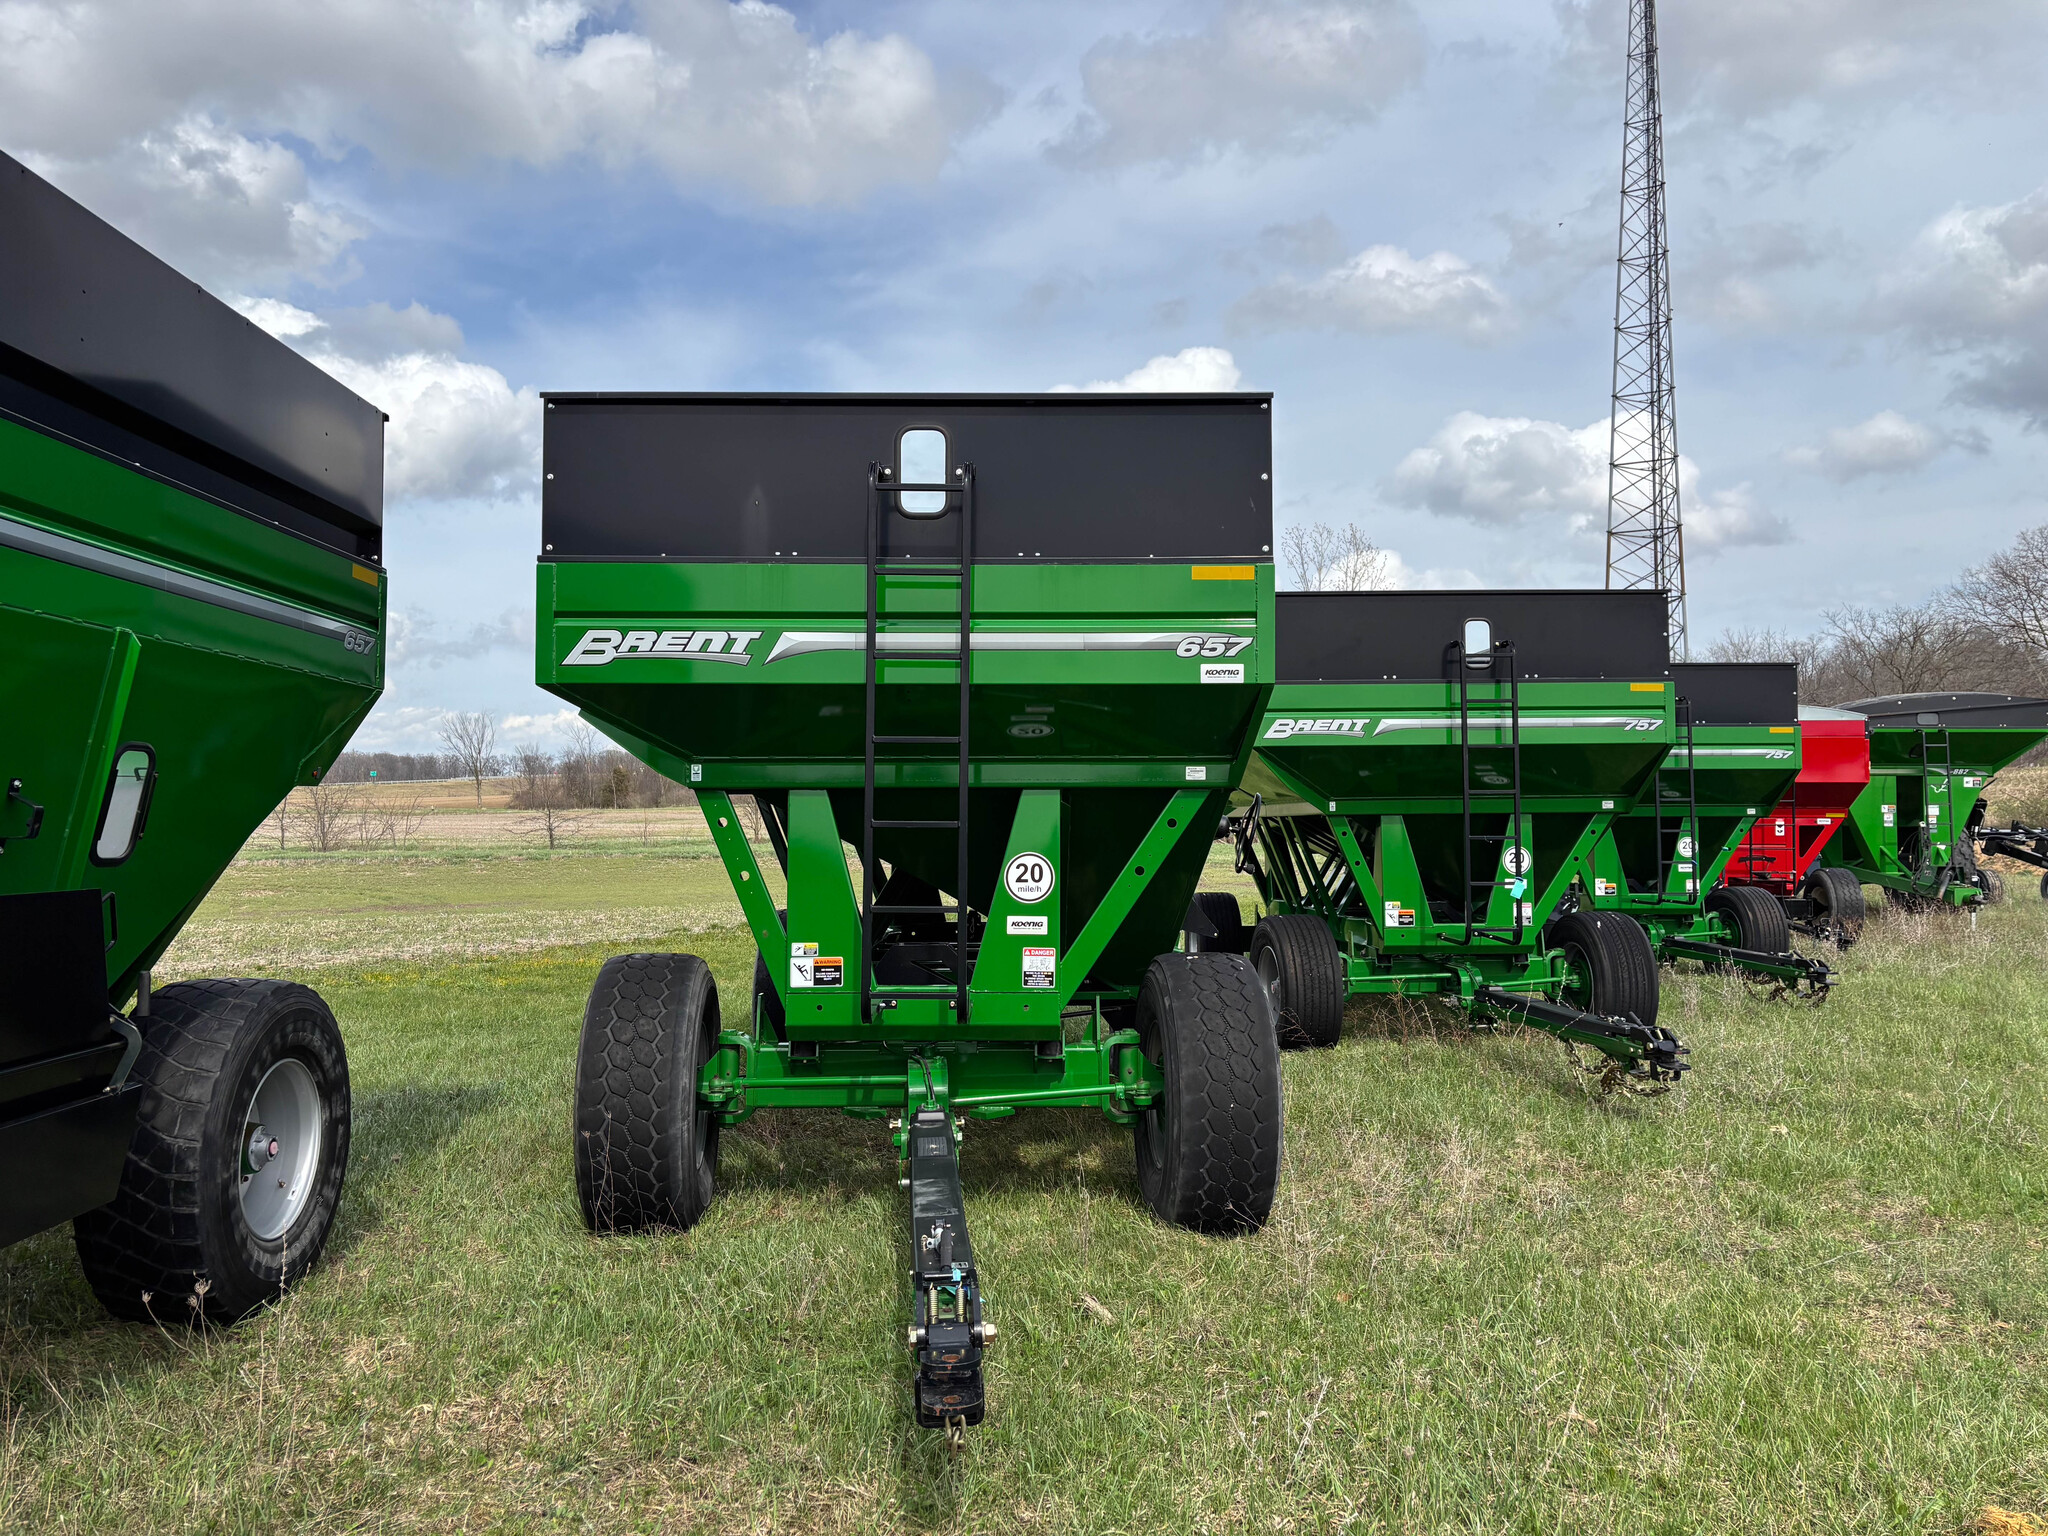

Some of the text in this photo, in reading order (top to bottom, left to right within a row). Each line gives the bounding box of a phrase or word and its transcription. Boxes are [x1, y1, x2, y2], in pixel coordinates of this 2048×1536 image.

[344, 630, 376, 656] 657
[560, 629, 764, 666] BRENT
[1176, 636, 1255, 658] 657
[1262, 718, 1371, 739] BRENT
[1623, 719, 1664, 731] 757
[1764, 750, 1794, 759] 757
[1015, 863, 1044, 883] 20
